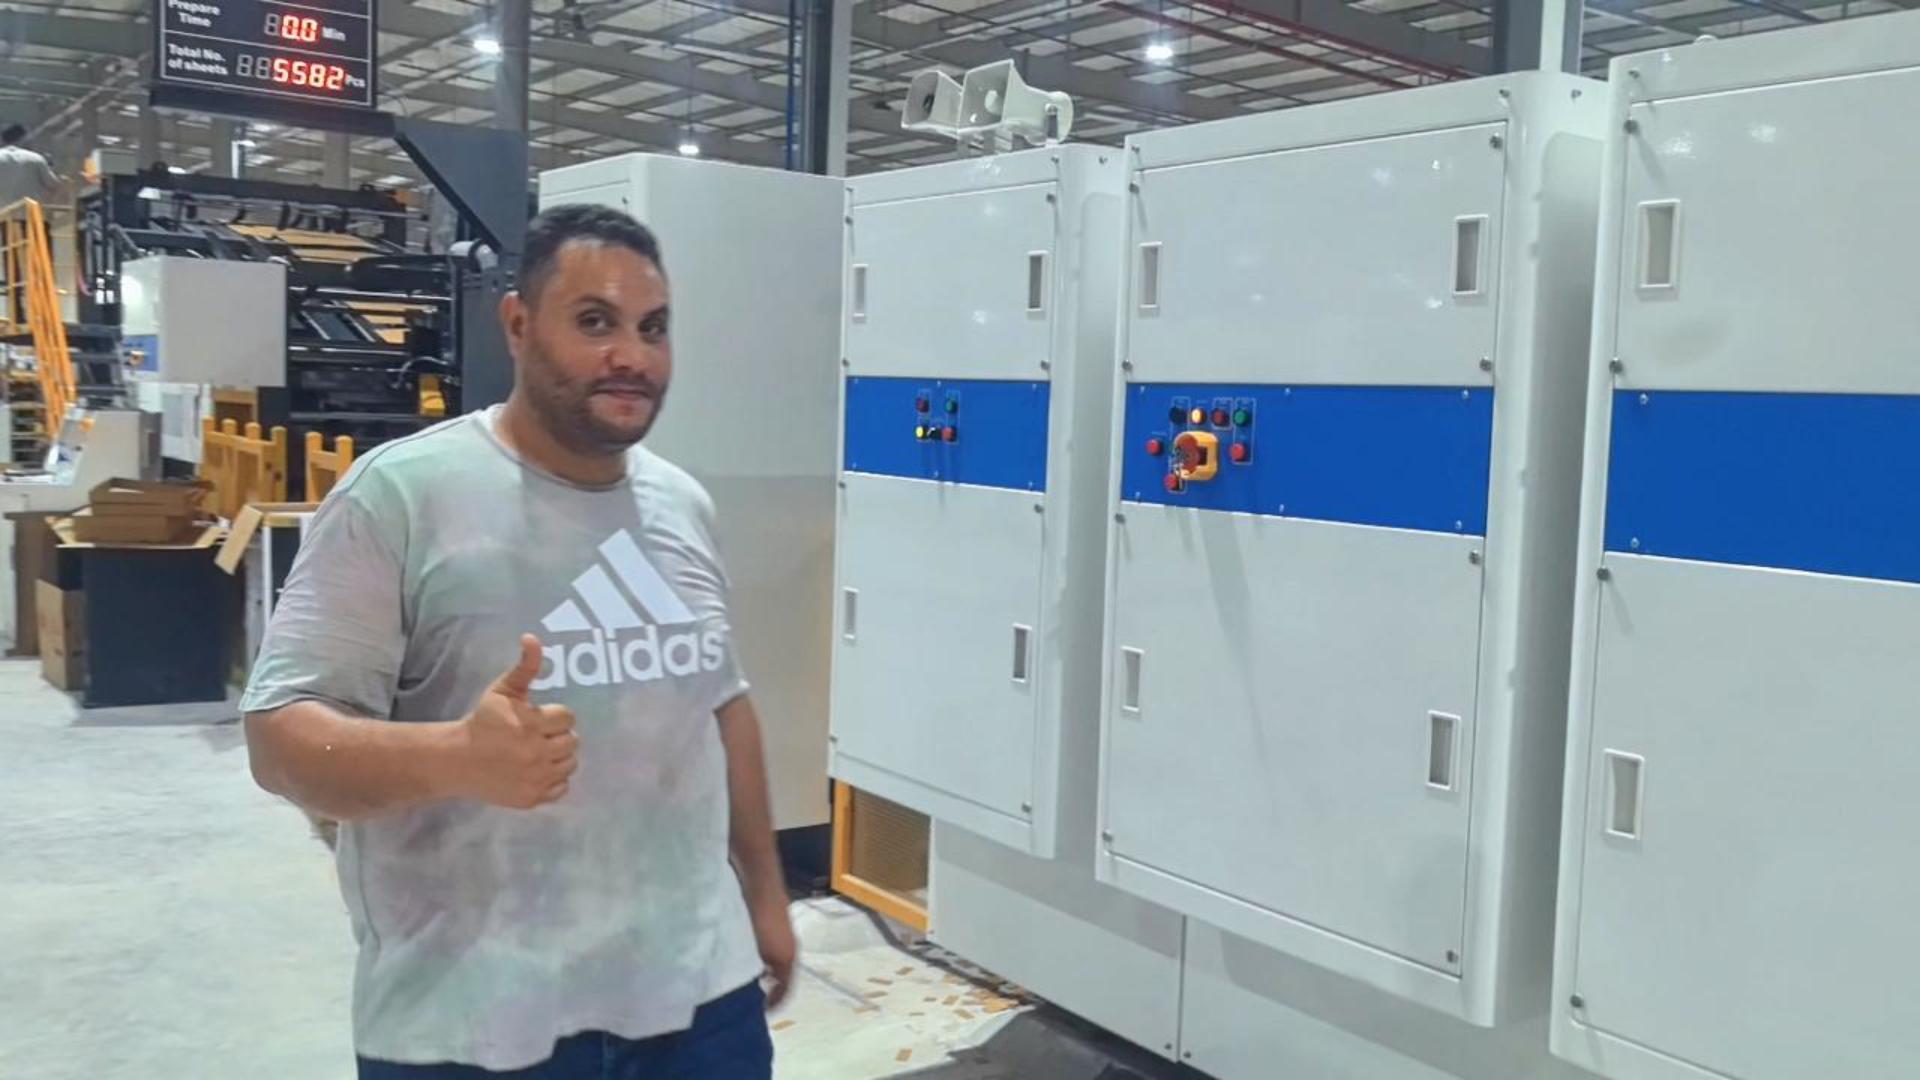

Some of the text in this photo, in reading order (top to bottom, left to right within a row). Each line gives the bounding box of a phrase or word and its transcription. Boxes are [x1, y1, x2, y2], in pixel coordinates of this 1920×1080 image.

[168, 0, 220, 15] Prepare
[177, 11, 212, 27] Time
[322, 26, 346, 42] Min
[168, 43, 202, 58] Total
[168, 58, 228, 75] of sheets
[345, 73, 366, 88] Pcs
[528, 623, 724, 690] adidas
